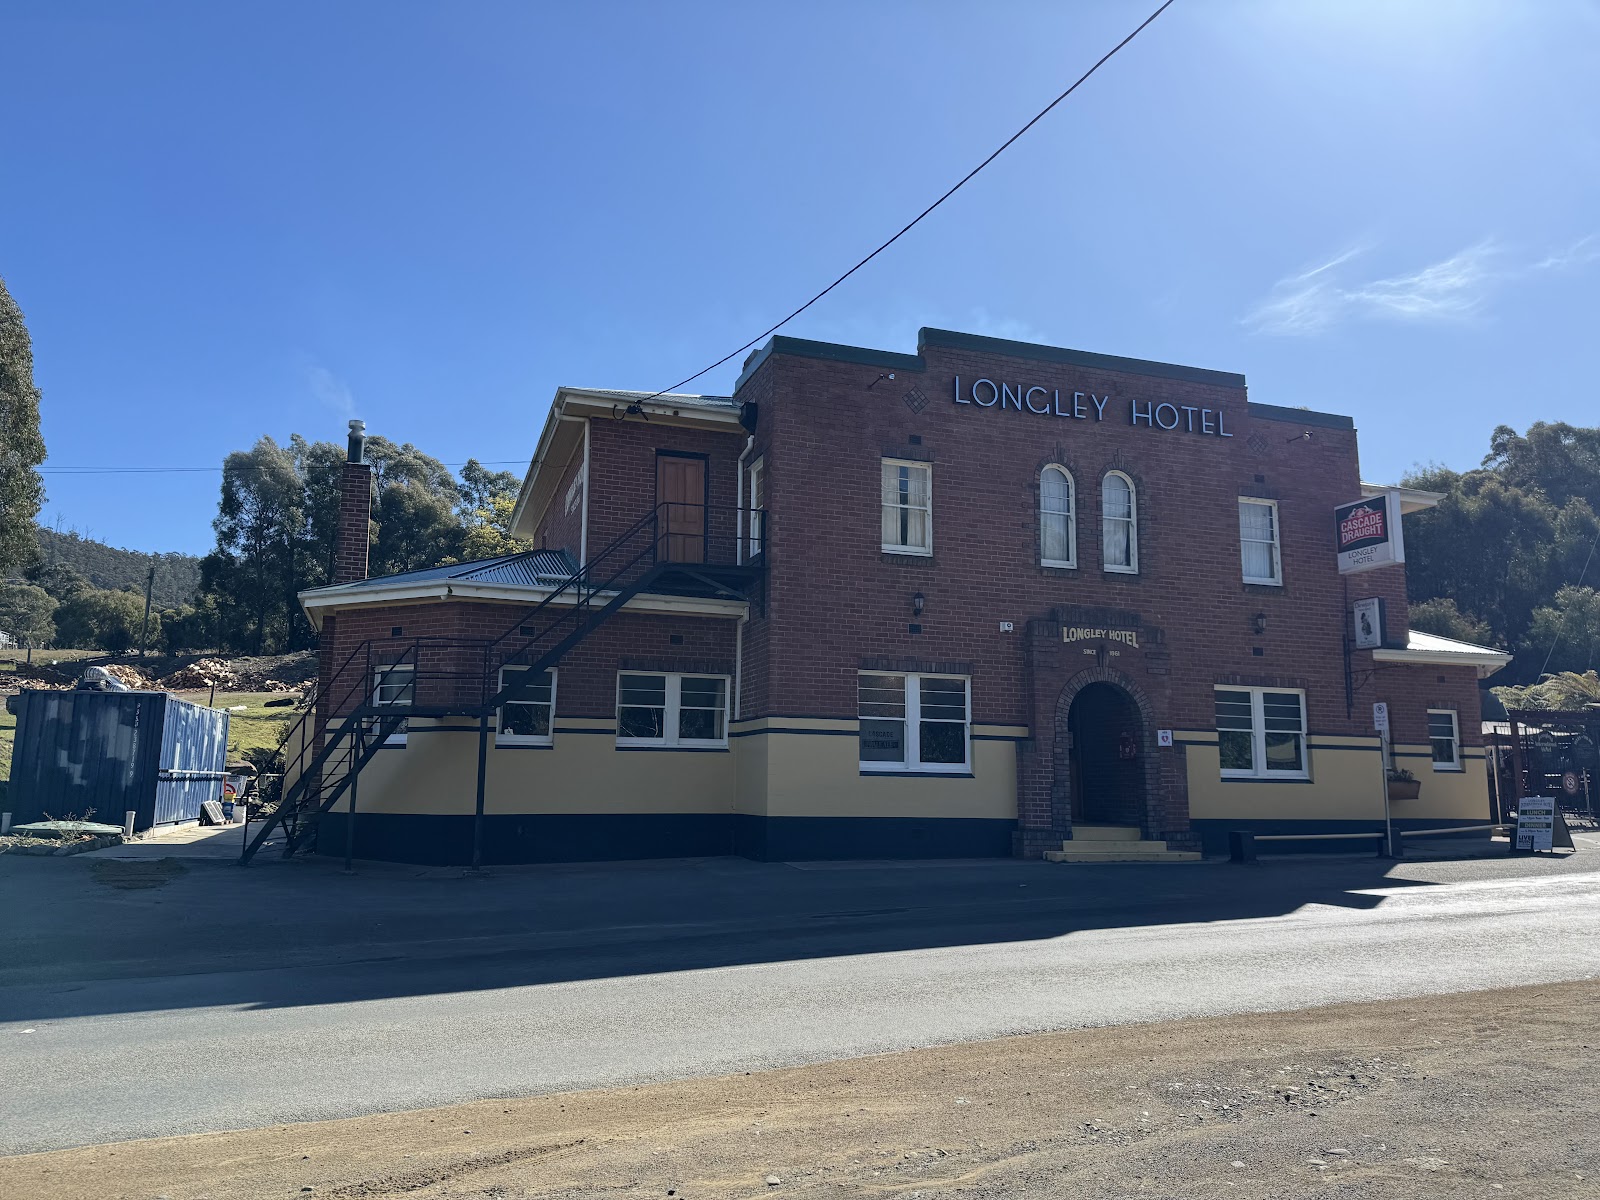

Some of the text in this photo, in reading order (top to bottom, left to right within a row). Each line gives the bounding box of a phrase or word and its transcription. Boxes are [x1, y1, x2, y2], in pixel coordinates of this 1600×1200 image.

[952, 375, 1234, 437] LONGLEY HOTEL
[1341, 513, 1382, 532] CASCADE
[1342, 523, 1383, 544] DRAUGHT
[1348, 546, 1378, 559] LONGLEY
[1353, 556, 1374, 566] HOTEL
[1063, 626, 1139, 649] LONGLEY HOTEL
[1082, 648, 1097, 656] SINCE
